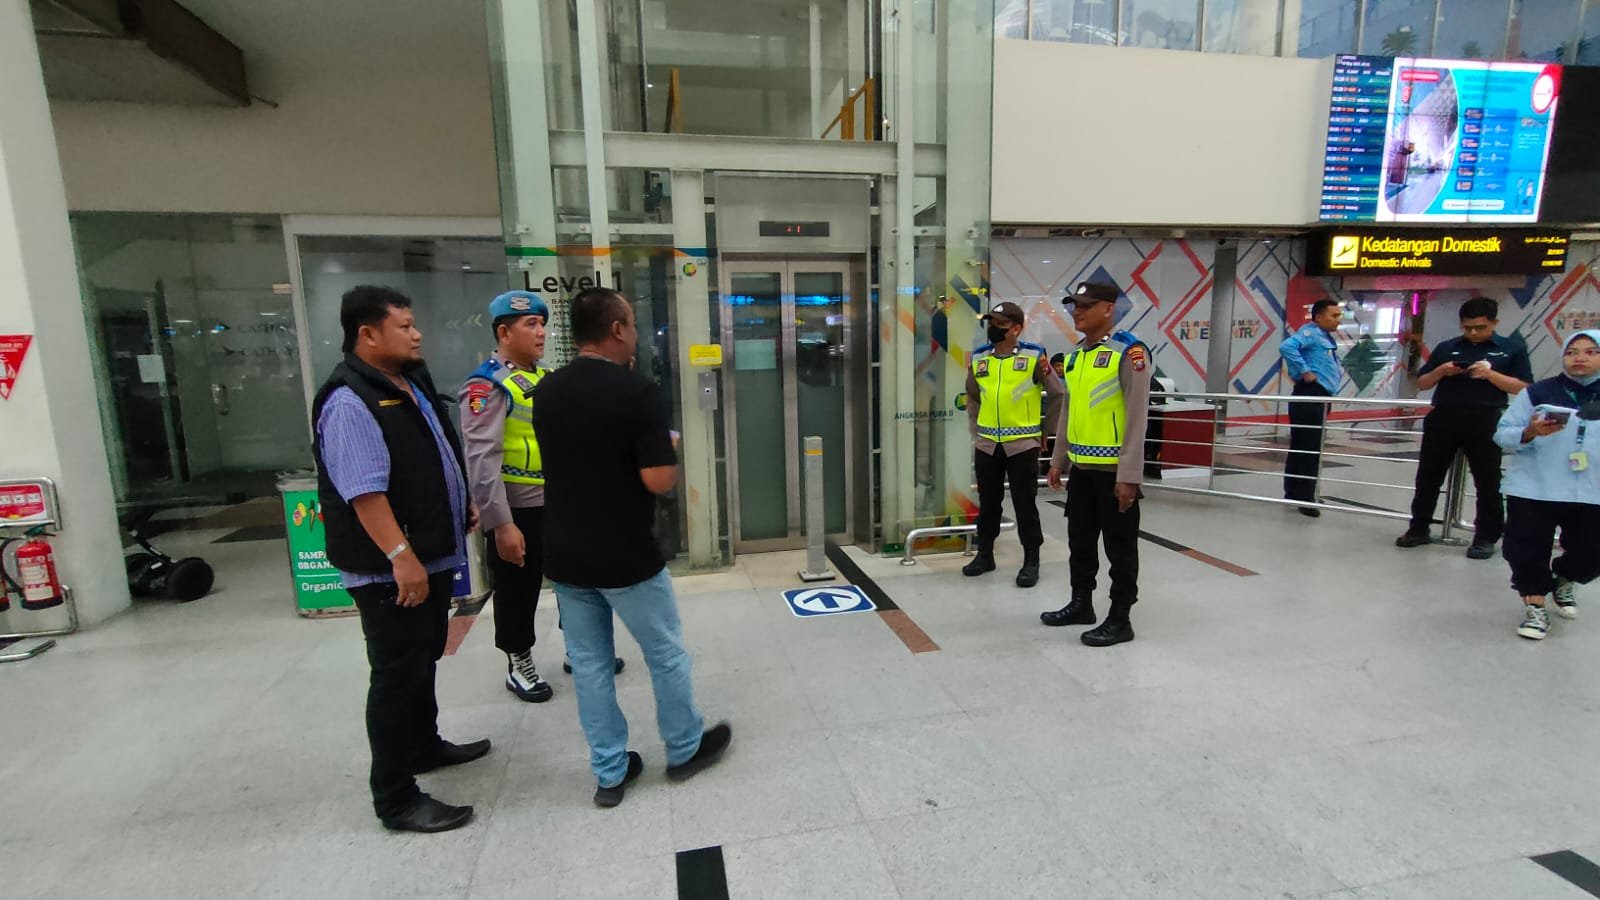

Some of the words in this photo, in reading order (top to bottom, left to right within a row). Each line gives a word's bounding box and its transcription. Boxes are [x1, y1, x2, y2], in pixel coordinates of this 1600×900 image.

[1362, 237, 1439, 255] Kedatangan
[1442, 236, 1501, 252] Domestik
[1361, 257, 1399, 268] Domestic
[1401, 257, 1432, 268] Arrivals
[524, 270, 602, 292] Level
[611, 270, 622, 292] 1
[302, 581, 343, 592] Organic
